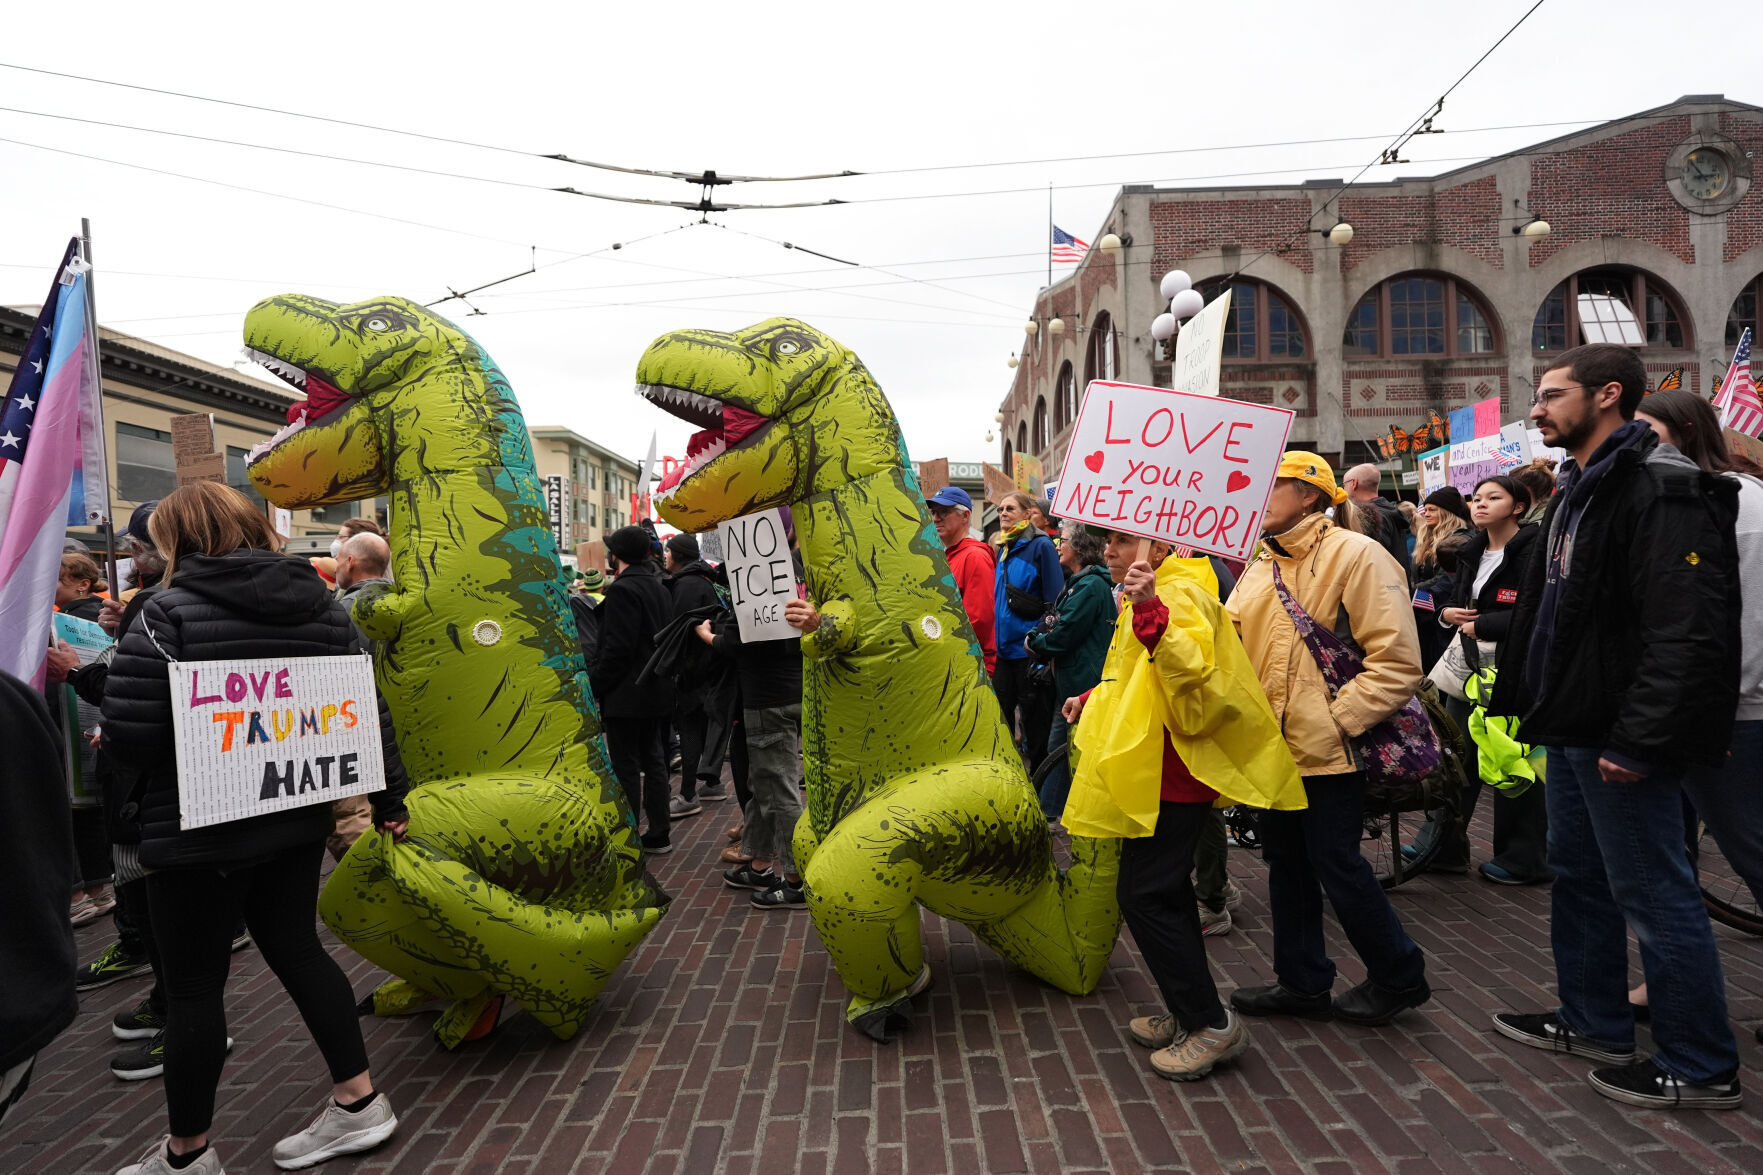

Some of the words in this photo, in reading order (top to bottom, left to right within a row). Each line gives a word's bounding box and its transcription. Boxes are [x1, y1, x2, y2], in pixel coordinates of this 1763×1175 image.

[1191, 313, 1205, 340] NO
[1105, 400, 1253, 463] LOVE
[1121, 458, 1204, 493] YOUR
[1424, 455, 1440, 472] WE
[550, 477, 560, 490] LA
[550, 491, 560, 522] SALLE
[1065, 482, 1258, 557] NEIGHBOR!
[727, 516, 777, 560] NO
[731, 559, 790, 606] ICE
[65, 625, 79, 634] Tools
[754, 603, 779, 627] AGE
[190, 667, 293, 709] LOVE
[212, 699, 358, 753] TRUMPS
[259, 752, 359, 801] HATE
